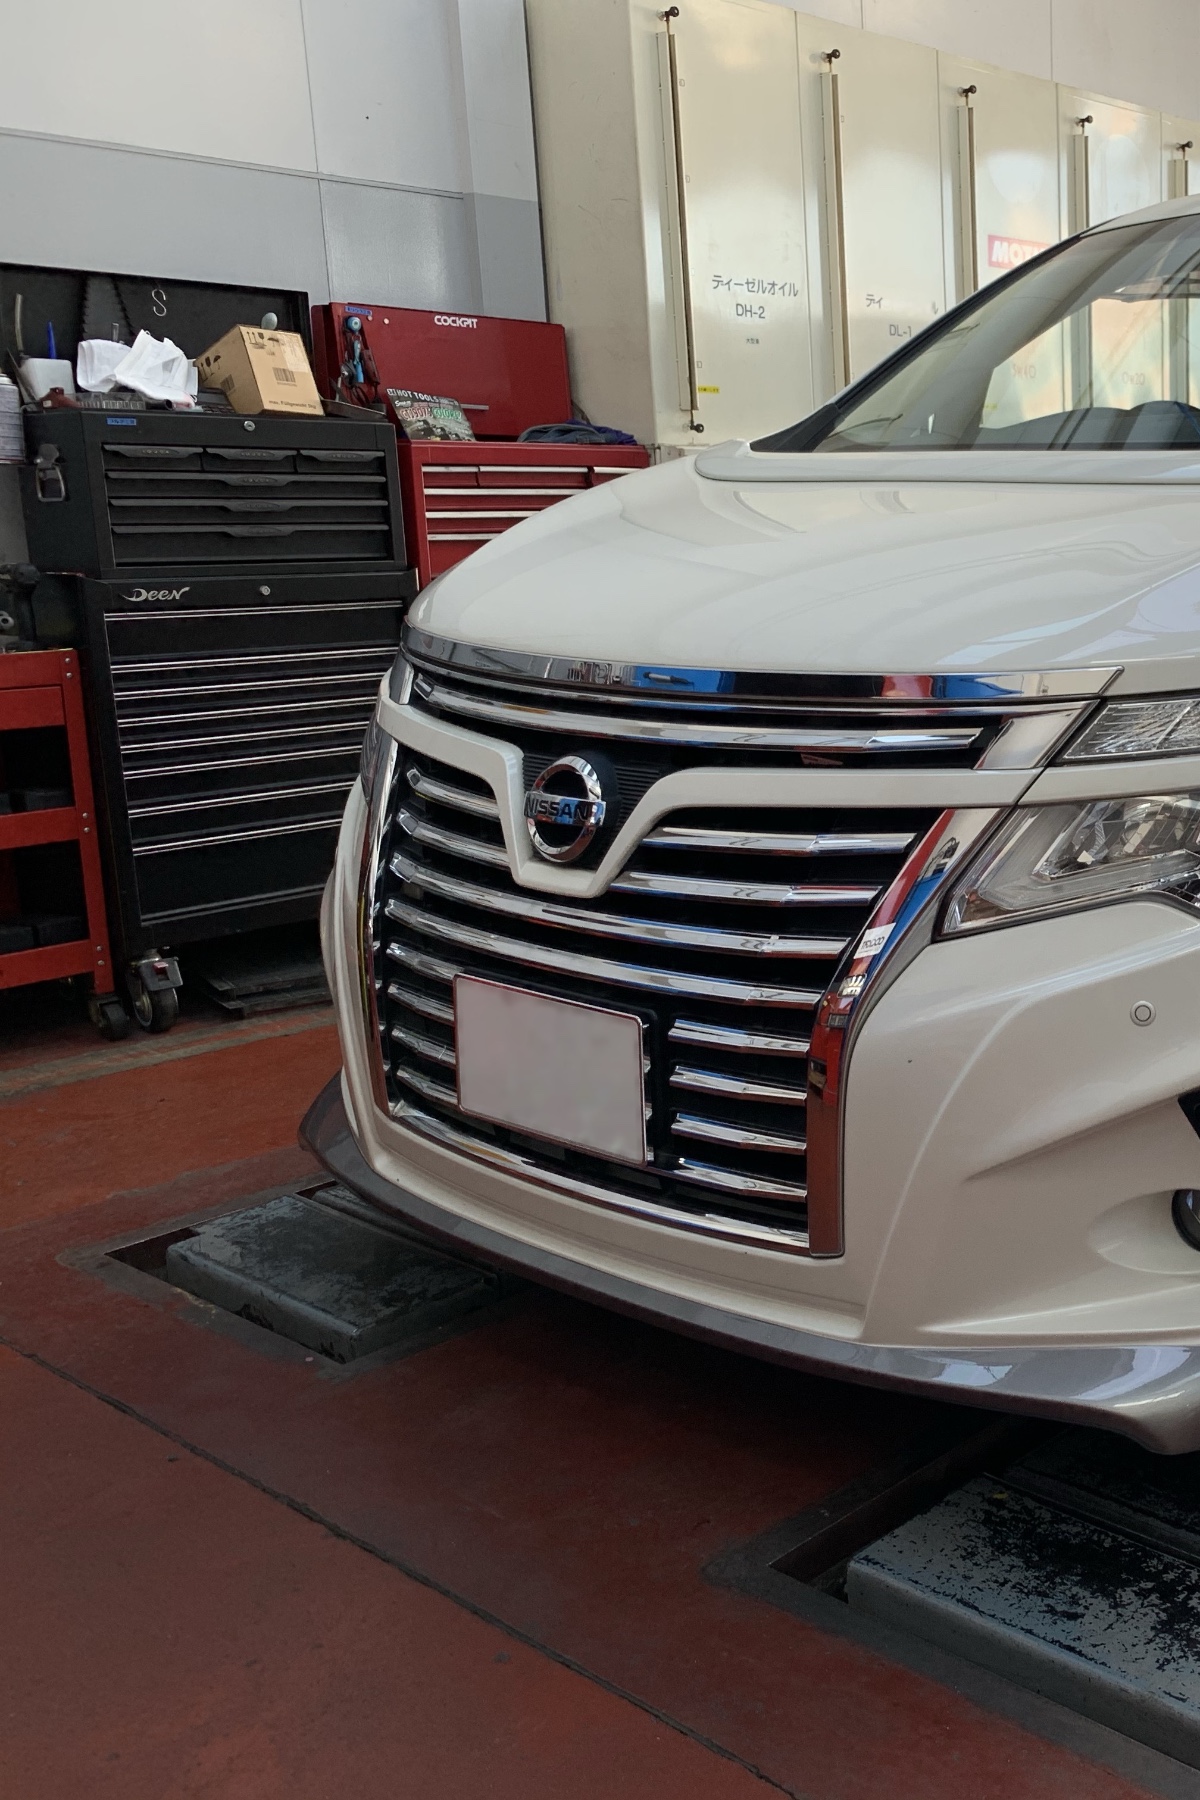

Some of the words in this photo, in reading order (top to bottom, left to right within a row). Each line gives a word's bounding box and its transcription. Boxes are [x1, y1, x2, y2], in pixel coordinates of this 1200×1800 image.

[711, 274, 799, 297] ディーゼルオイル
[735, 303, 766, 319] DH-2
[434, 315, 478, 328] COCKPIT
[889, 324, 912, 338] DL-1
[396, 388, 413, 398] HOT
[414, 392, 439, 403] TOOLS
[523, 796, 590, 821] NISSAN
